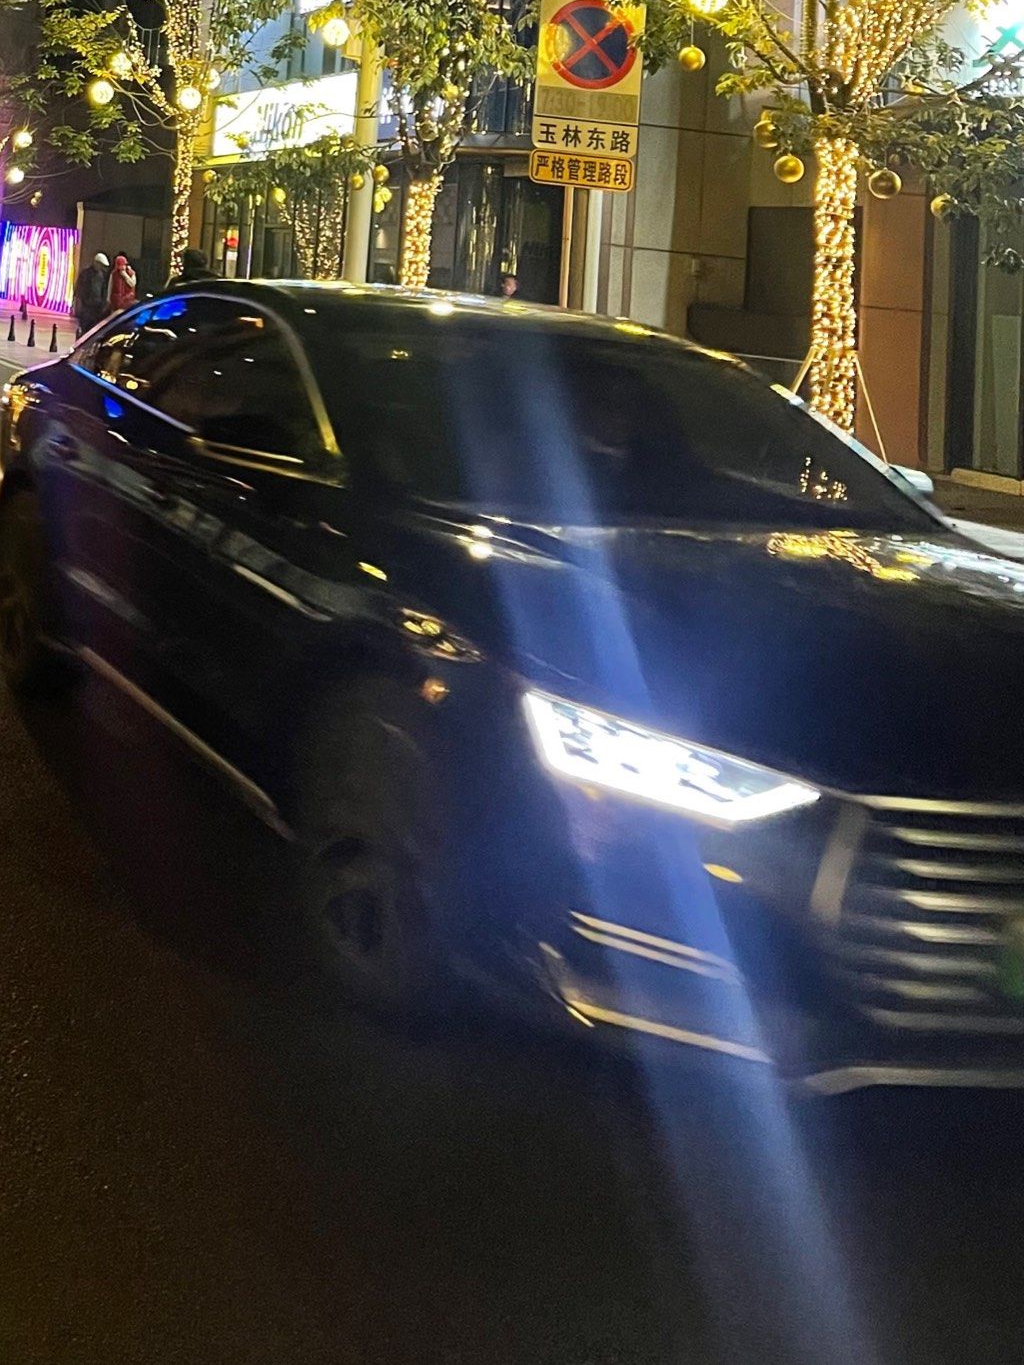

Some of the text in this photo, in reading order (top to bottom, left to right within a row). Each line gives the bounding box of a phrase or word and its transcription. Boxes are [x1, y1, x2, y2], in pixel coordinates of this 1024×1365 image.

[538, 123, 631, 153] 玉林东路
[535, 155, 628, 185] 严格管理路段
